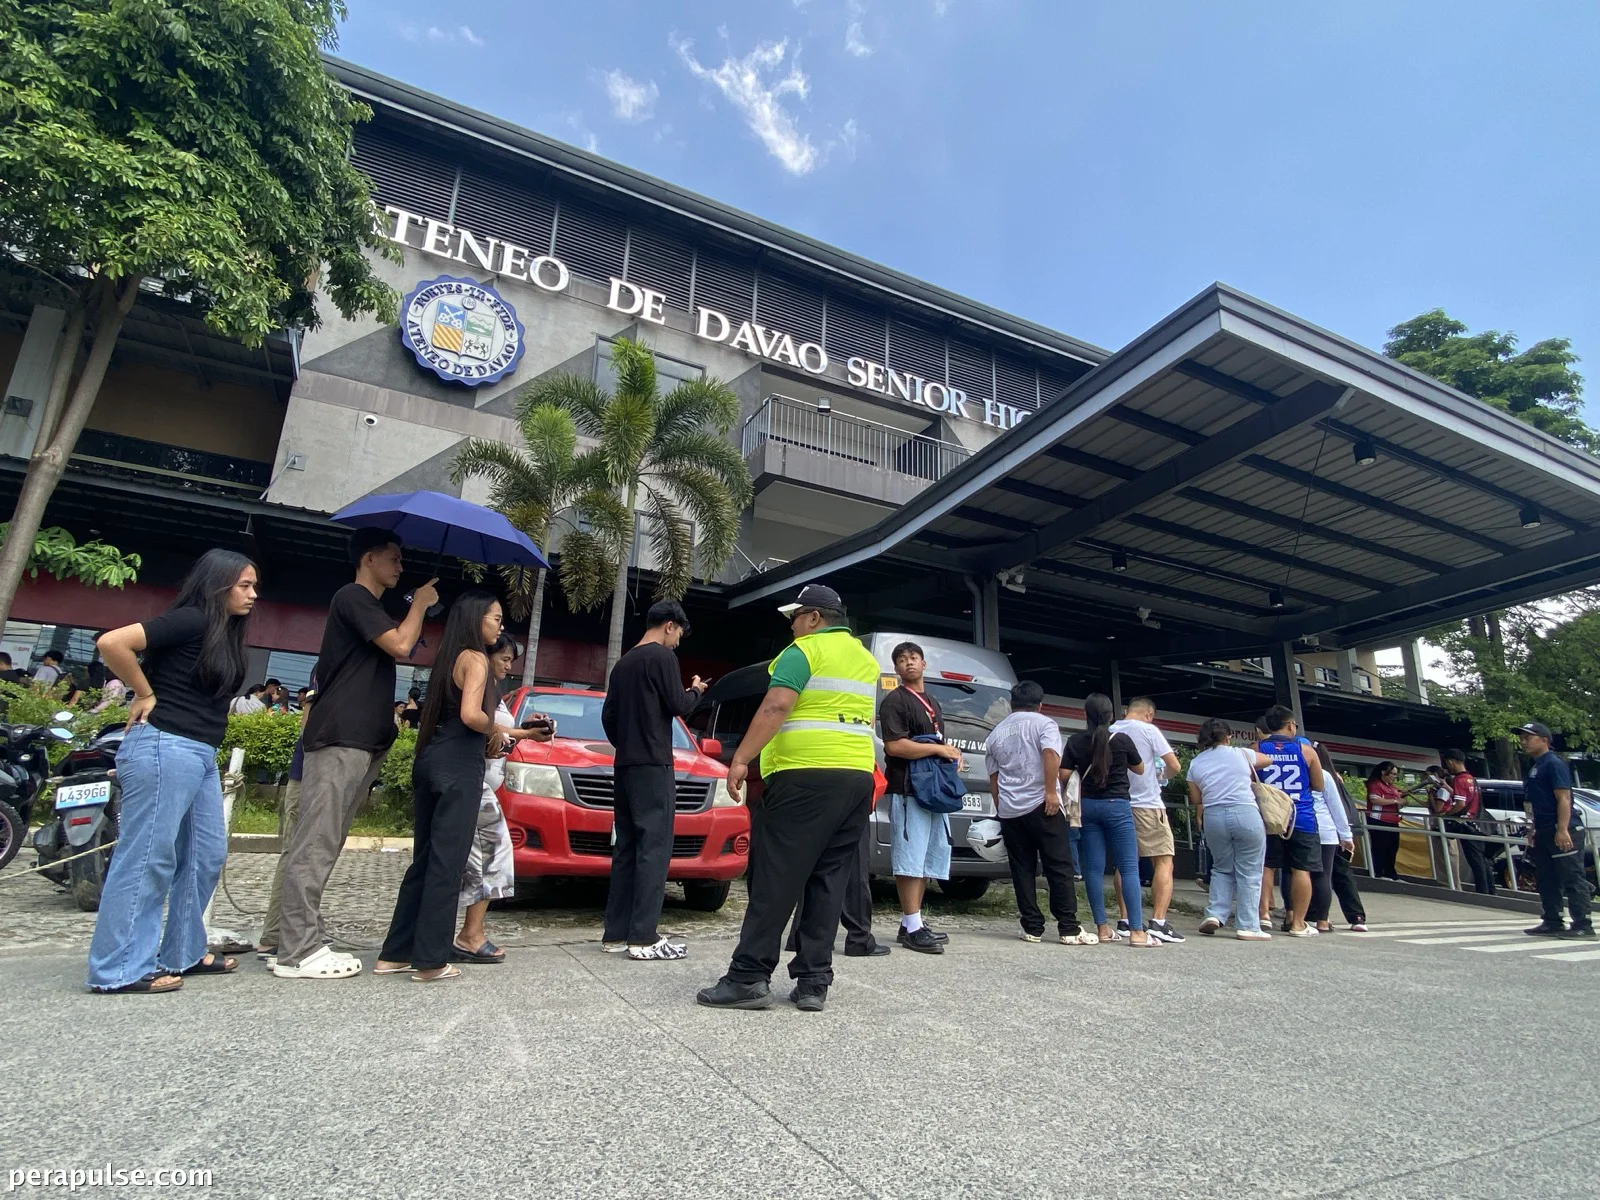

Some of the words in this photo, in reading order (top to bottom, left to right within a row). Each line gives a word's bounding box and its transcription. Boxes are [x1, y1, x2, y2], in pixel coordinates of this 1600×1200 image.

[408, 320, 450, 370] ATENEO
[452, 365, 474, 377] DE
[475, 344, 516, 377] DAVAO
[607, 277, 667, 325] DE
[697, 306, 828, 374] DAVAO
[847, 357, 970, 418] SENIOR
[1229, 729, 1258, 741] ercu
[1263, 764, 1302, 790] 22
[60, 786, 107, 802] L439GG
